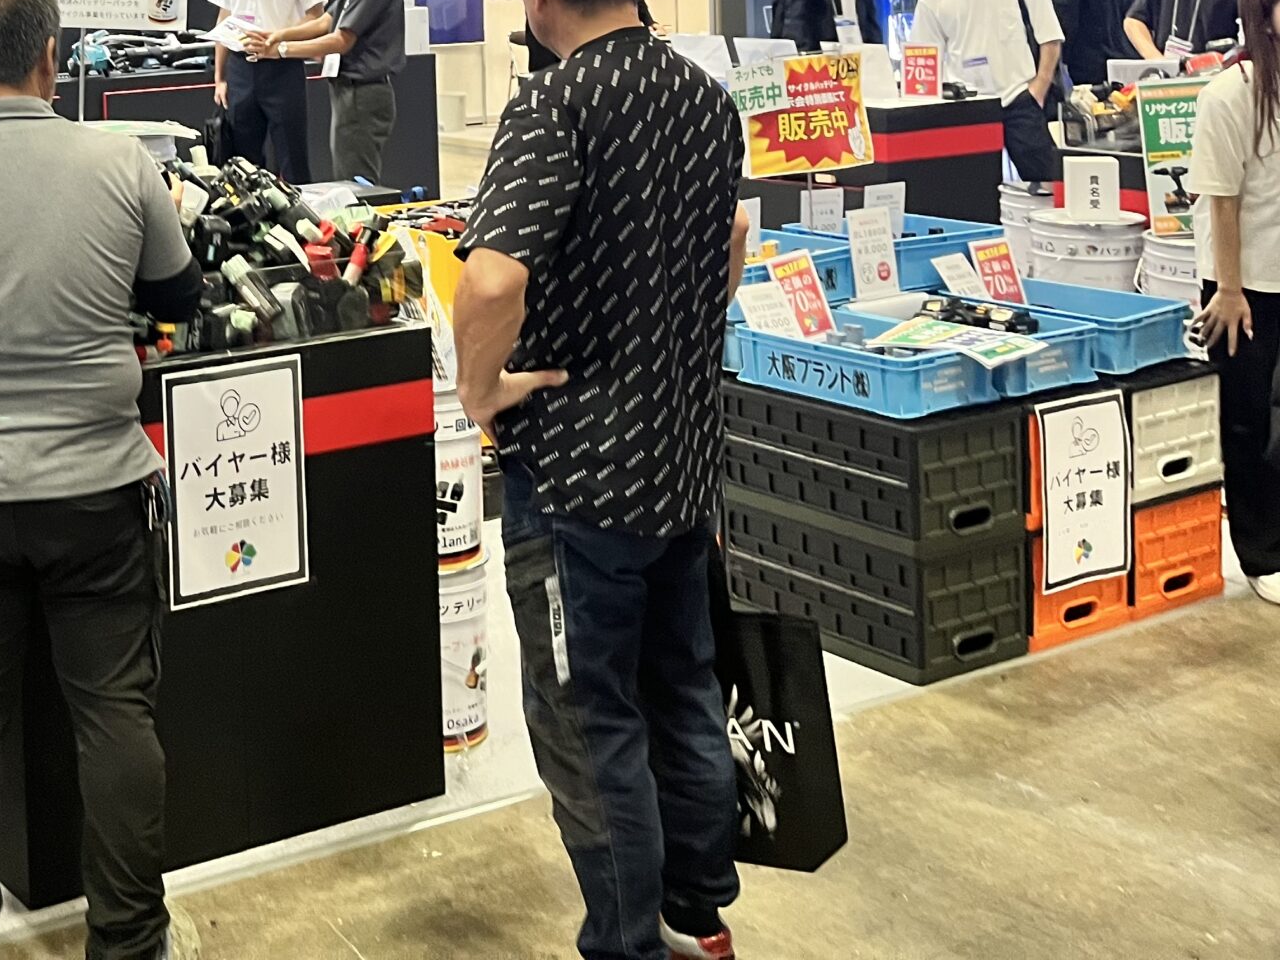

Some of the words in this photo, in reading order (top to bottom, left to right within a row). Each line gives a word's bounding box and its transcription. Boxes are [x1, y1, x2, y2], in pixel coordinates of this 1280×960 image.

[777, 106, 849, 143] 販売中
[180, 441, 291, 480] バイヤー様
[1050, 459, 1122, 490] バイヤー様
[205, 477, 270, 512] 大募集
[1063, 489, 1104, 515] 大募集
[437, 535, 468, 549] lant
